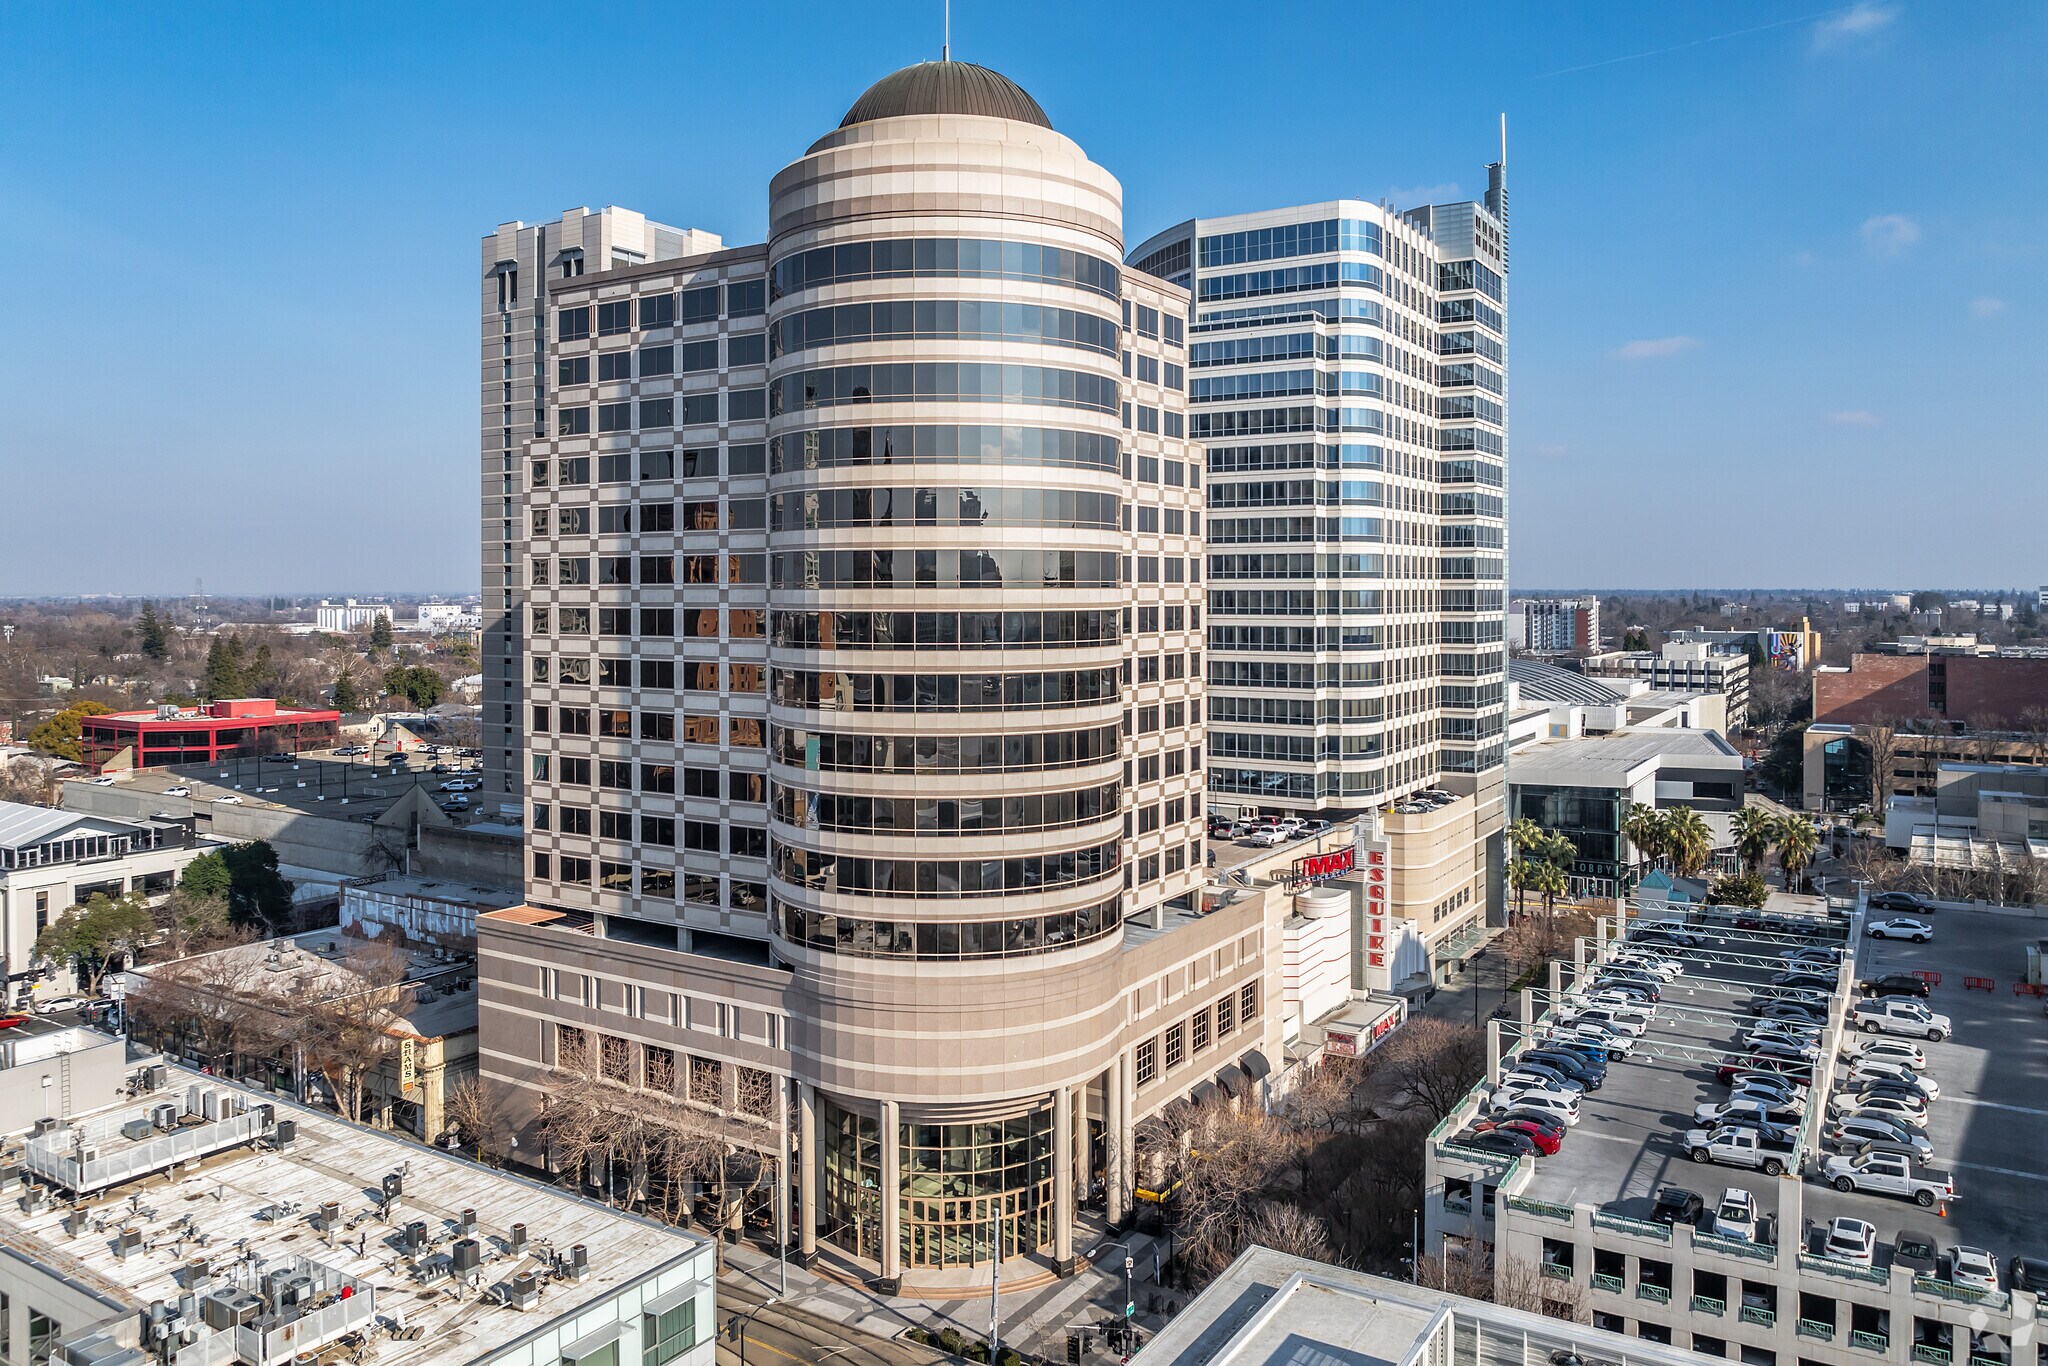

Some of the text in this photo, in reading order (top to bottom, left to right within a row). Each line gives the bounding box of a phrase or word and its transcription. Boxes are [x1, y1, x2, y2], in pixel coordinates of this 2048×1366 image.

[1303, 849, 1353, 876] IMAX
[1572, 861, 1612, 875] LOBBY
[1369, 851, 1384, 966] ESQUIRE
[1373, 1013, 1395, 1039] IMAX
